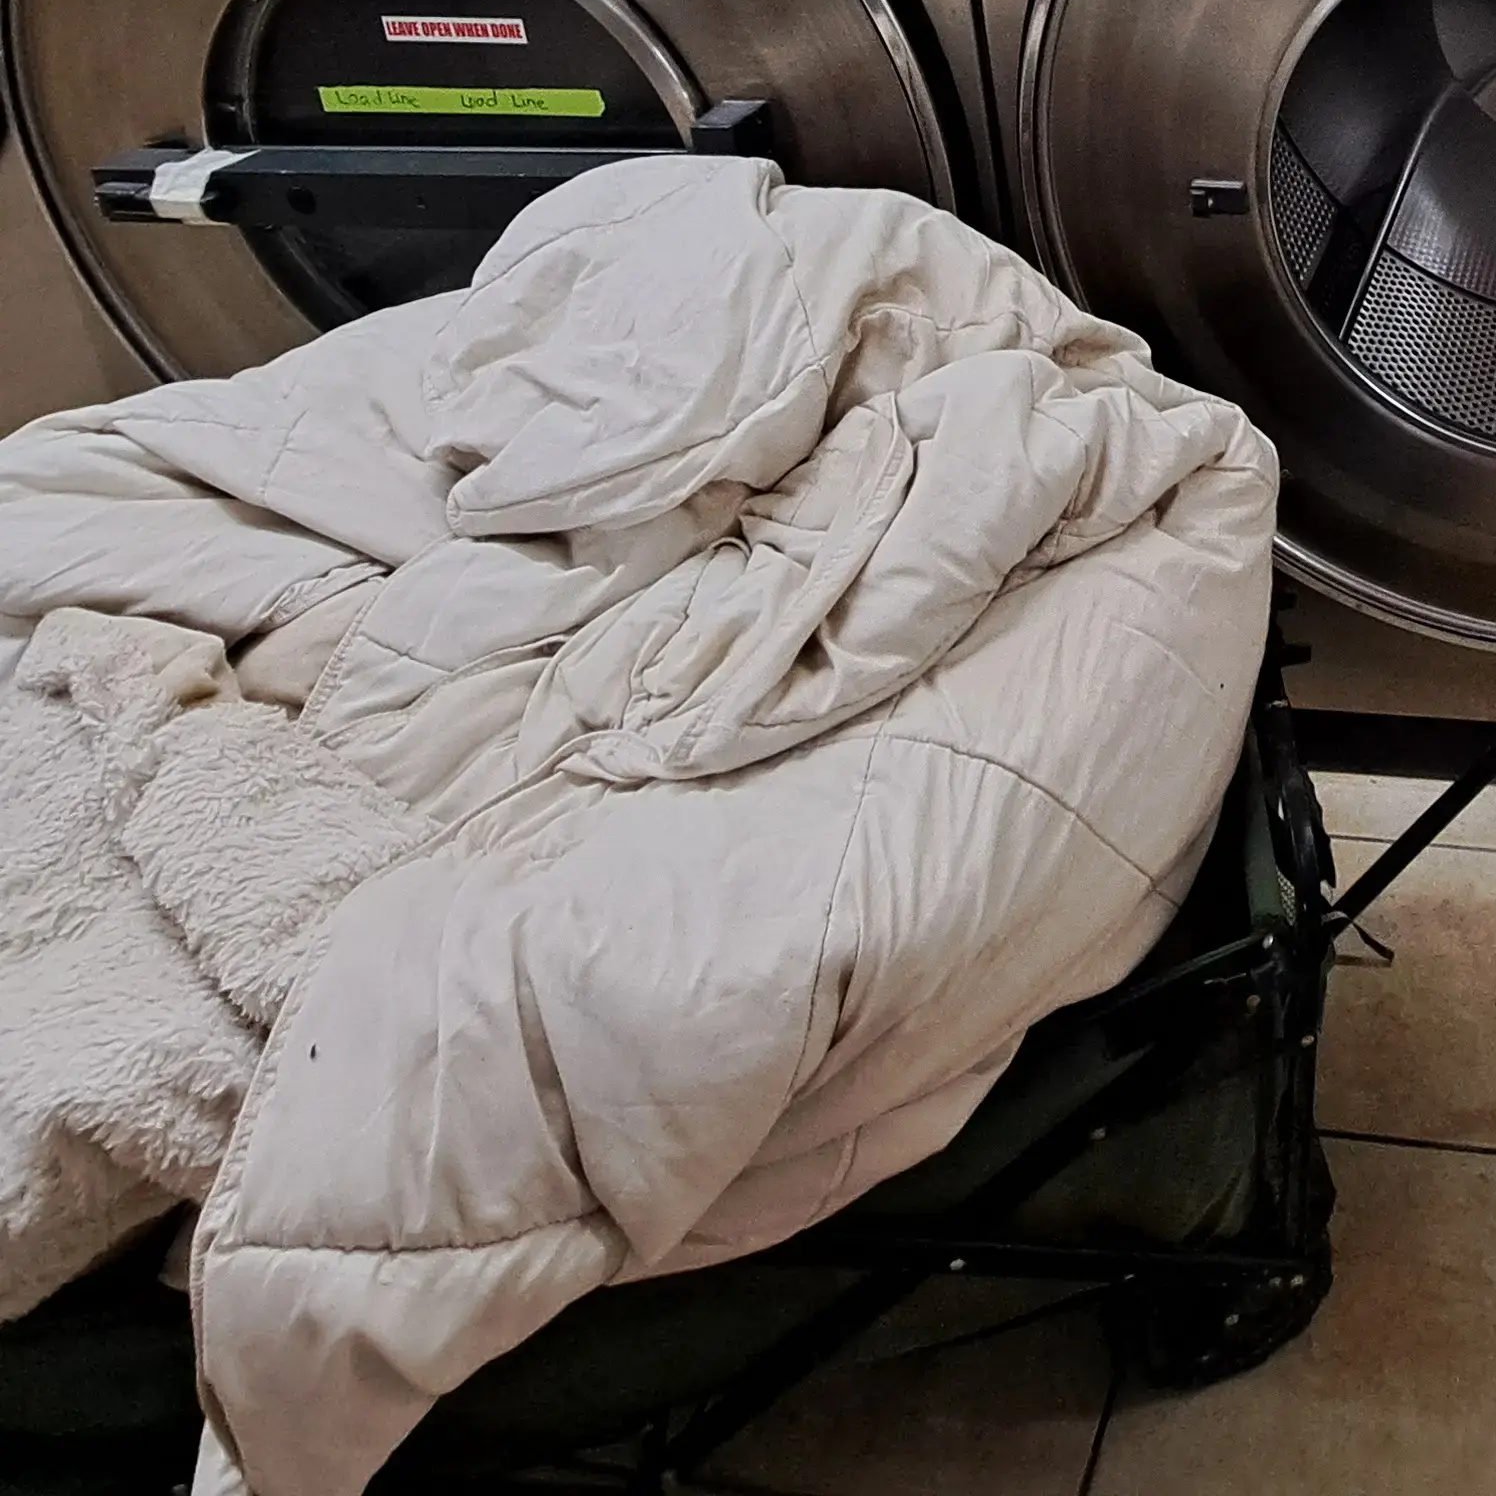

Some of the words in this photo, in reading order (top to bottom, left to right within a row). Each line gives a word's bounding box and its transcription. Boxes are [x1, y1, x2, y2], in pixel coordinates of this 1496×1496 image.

[386, 21, 419, 37] LEAVE
[422, 22, 451, 37] OPEN
[452, 22, 489, 38] WHEN
[491, 24, 523, 39] DONE
